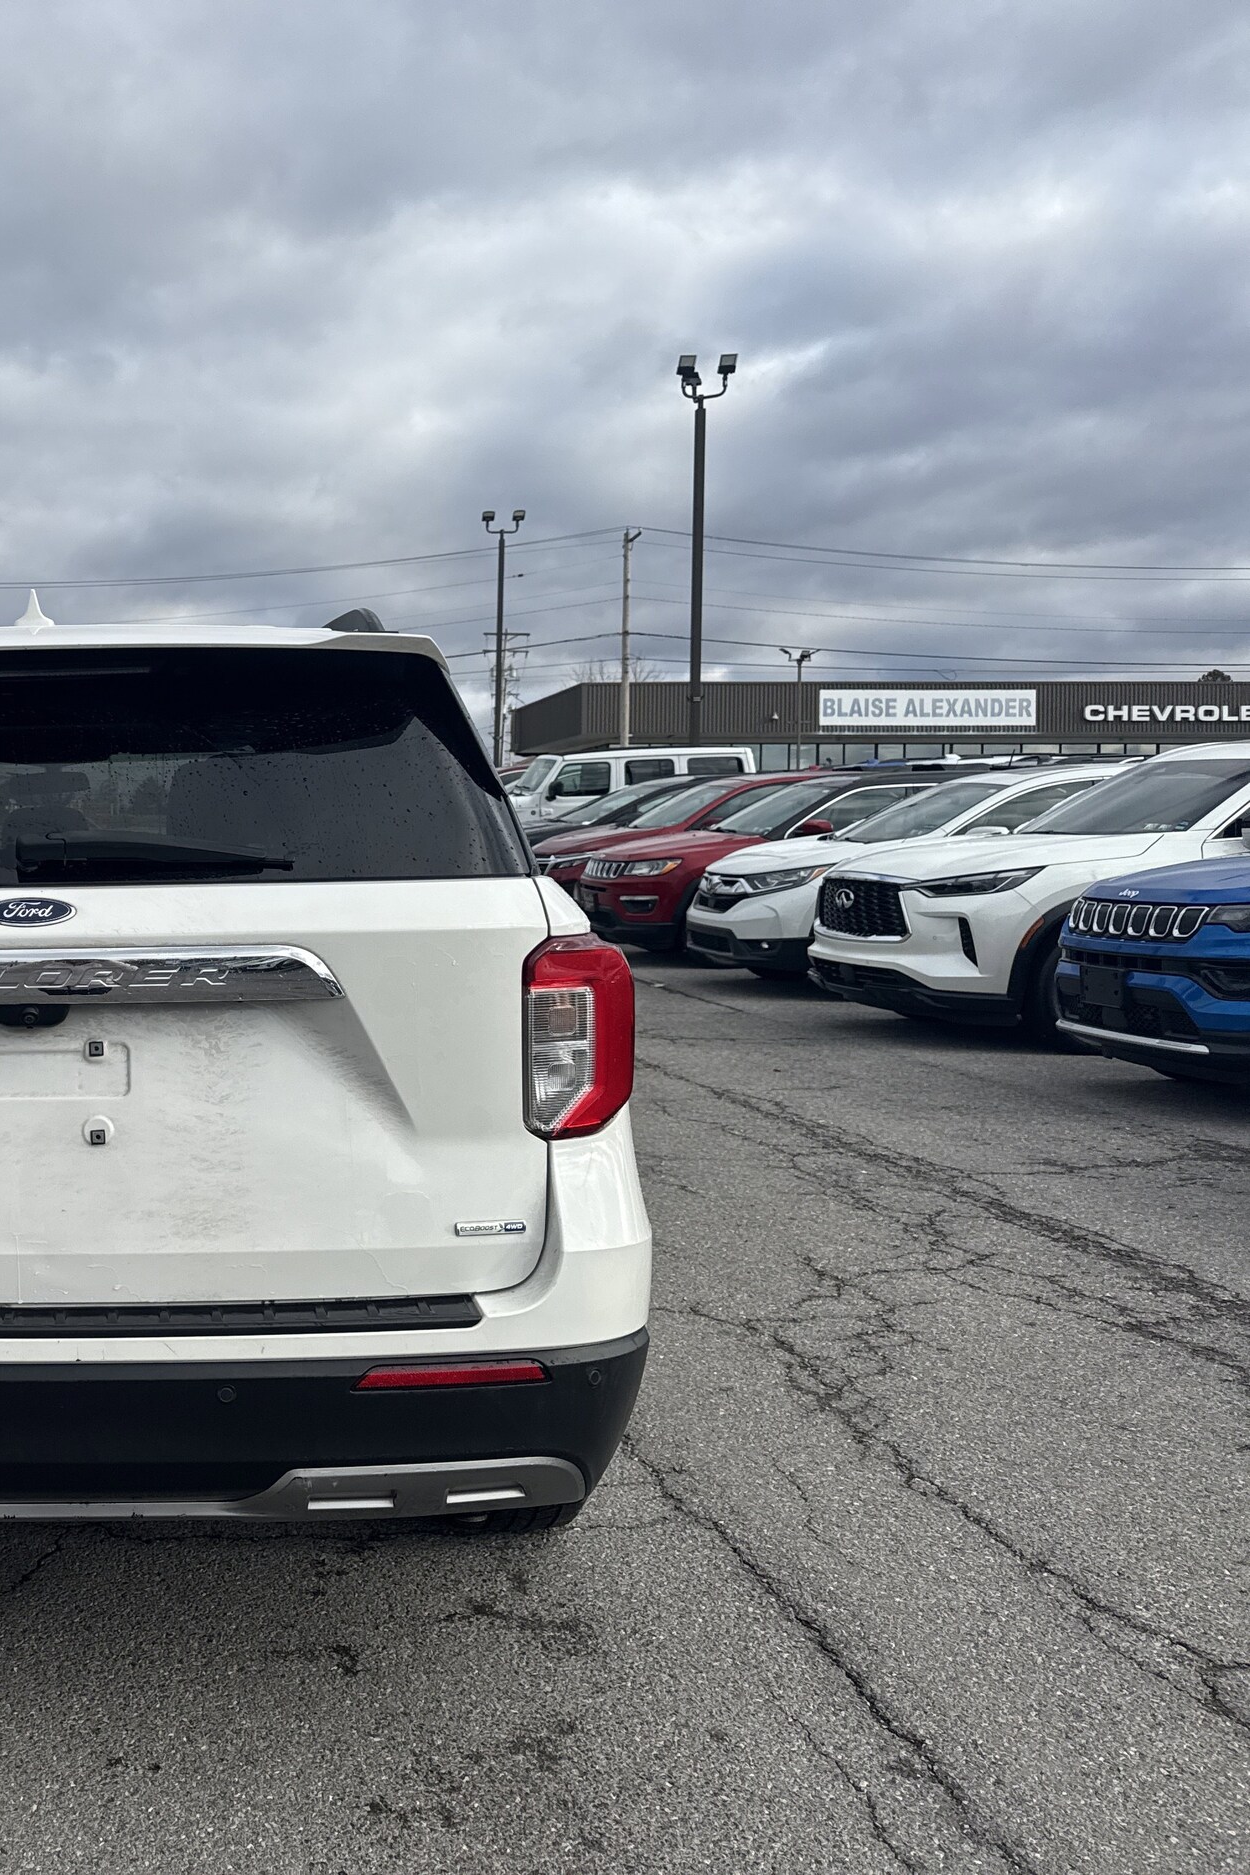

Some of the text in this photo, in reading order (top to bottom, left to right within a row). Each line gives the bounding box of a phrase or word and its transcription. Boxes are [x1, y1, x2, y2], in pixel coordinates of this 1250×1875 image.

[822, 698, 1033, 718] BLAISE ALEXANDER
[3, 901, 54, 918] Ford
[505, 1223, 523, 1231] 4WD
